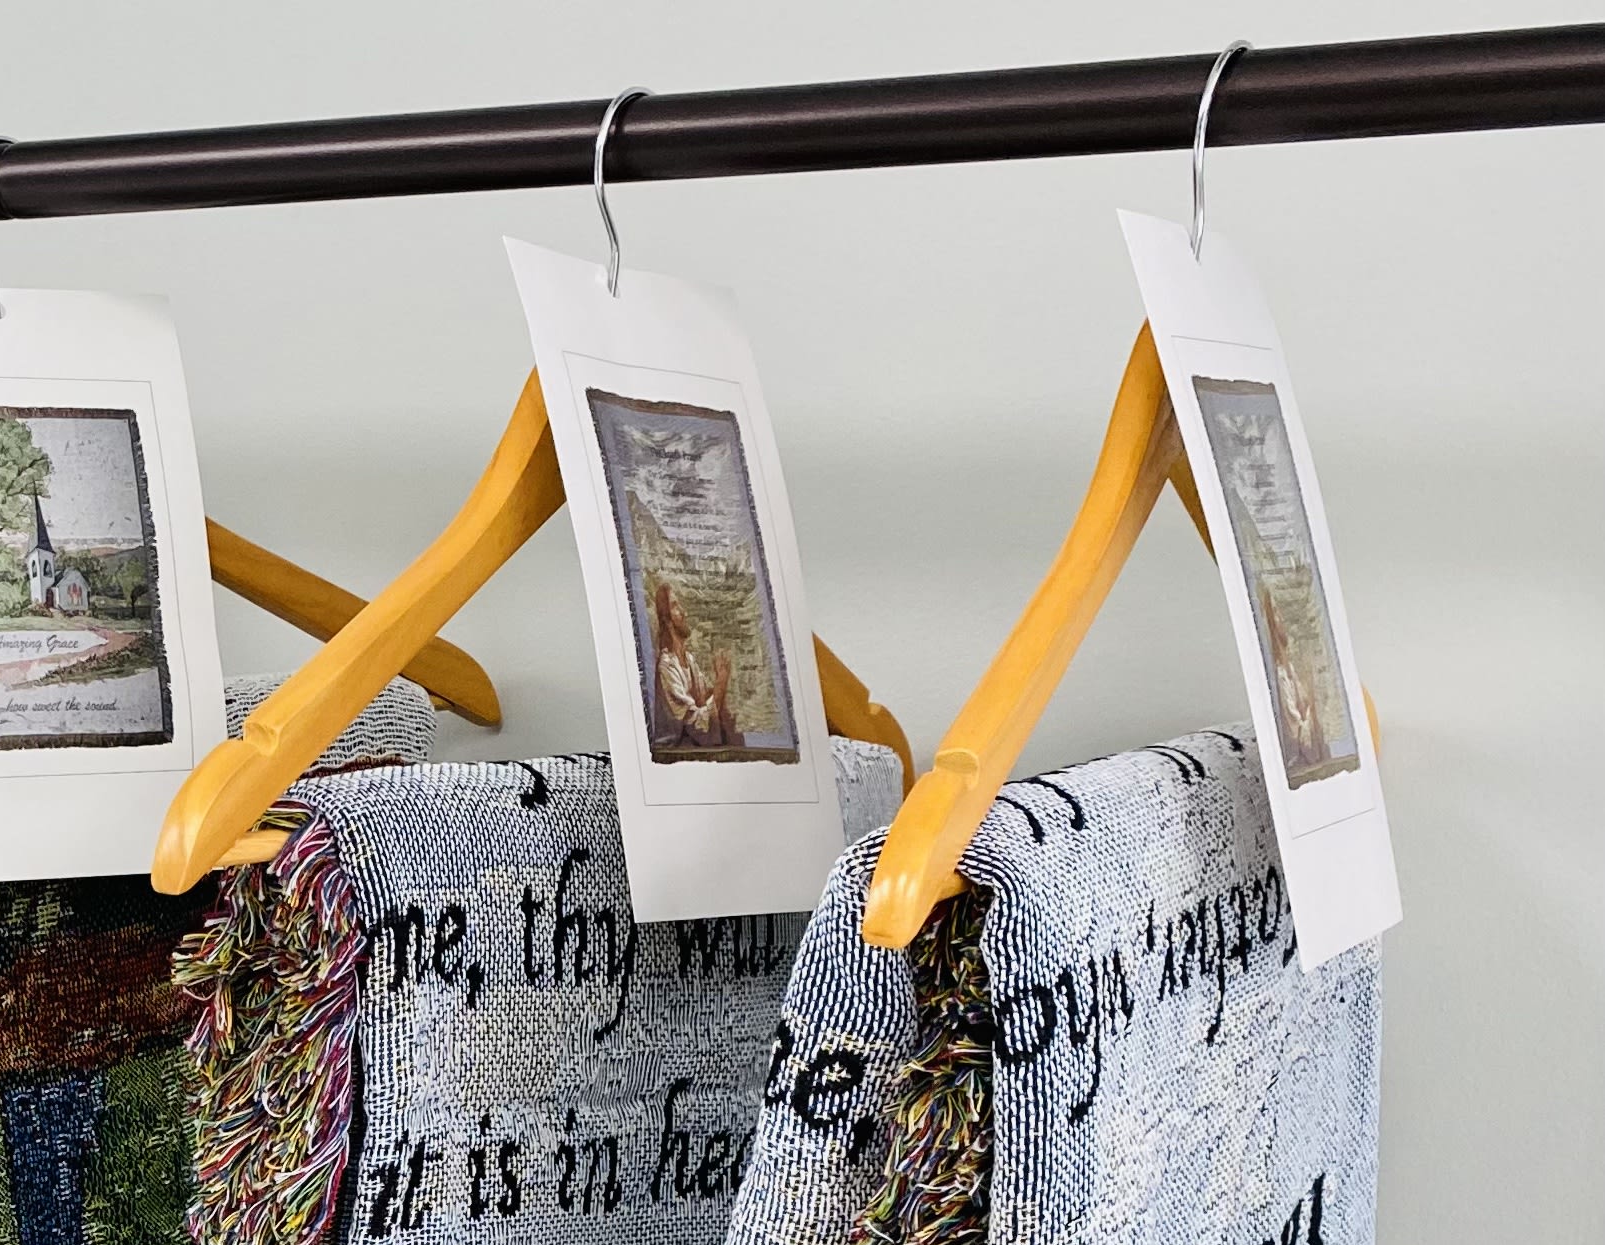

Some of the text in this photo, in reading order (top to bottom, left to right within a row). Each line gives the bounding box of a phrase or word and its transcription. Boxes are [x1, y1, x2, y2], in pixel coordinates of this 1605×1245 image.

[5, 698, 28, 712] how
[32, 700, 61, 712] sweet
[65, 696, 80, 711] the
[46, 634, 79, 653] Grace
[522, 849, 638, 1041] thy
[1145, 864, 1296, 1048] ather,
[363, 1128, 444, 1239] it
[468, 1112, 523, 1221] is
[555, 1108, 623, 1216] in
